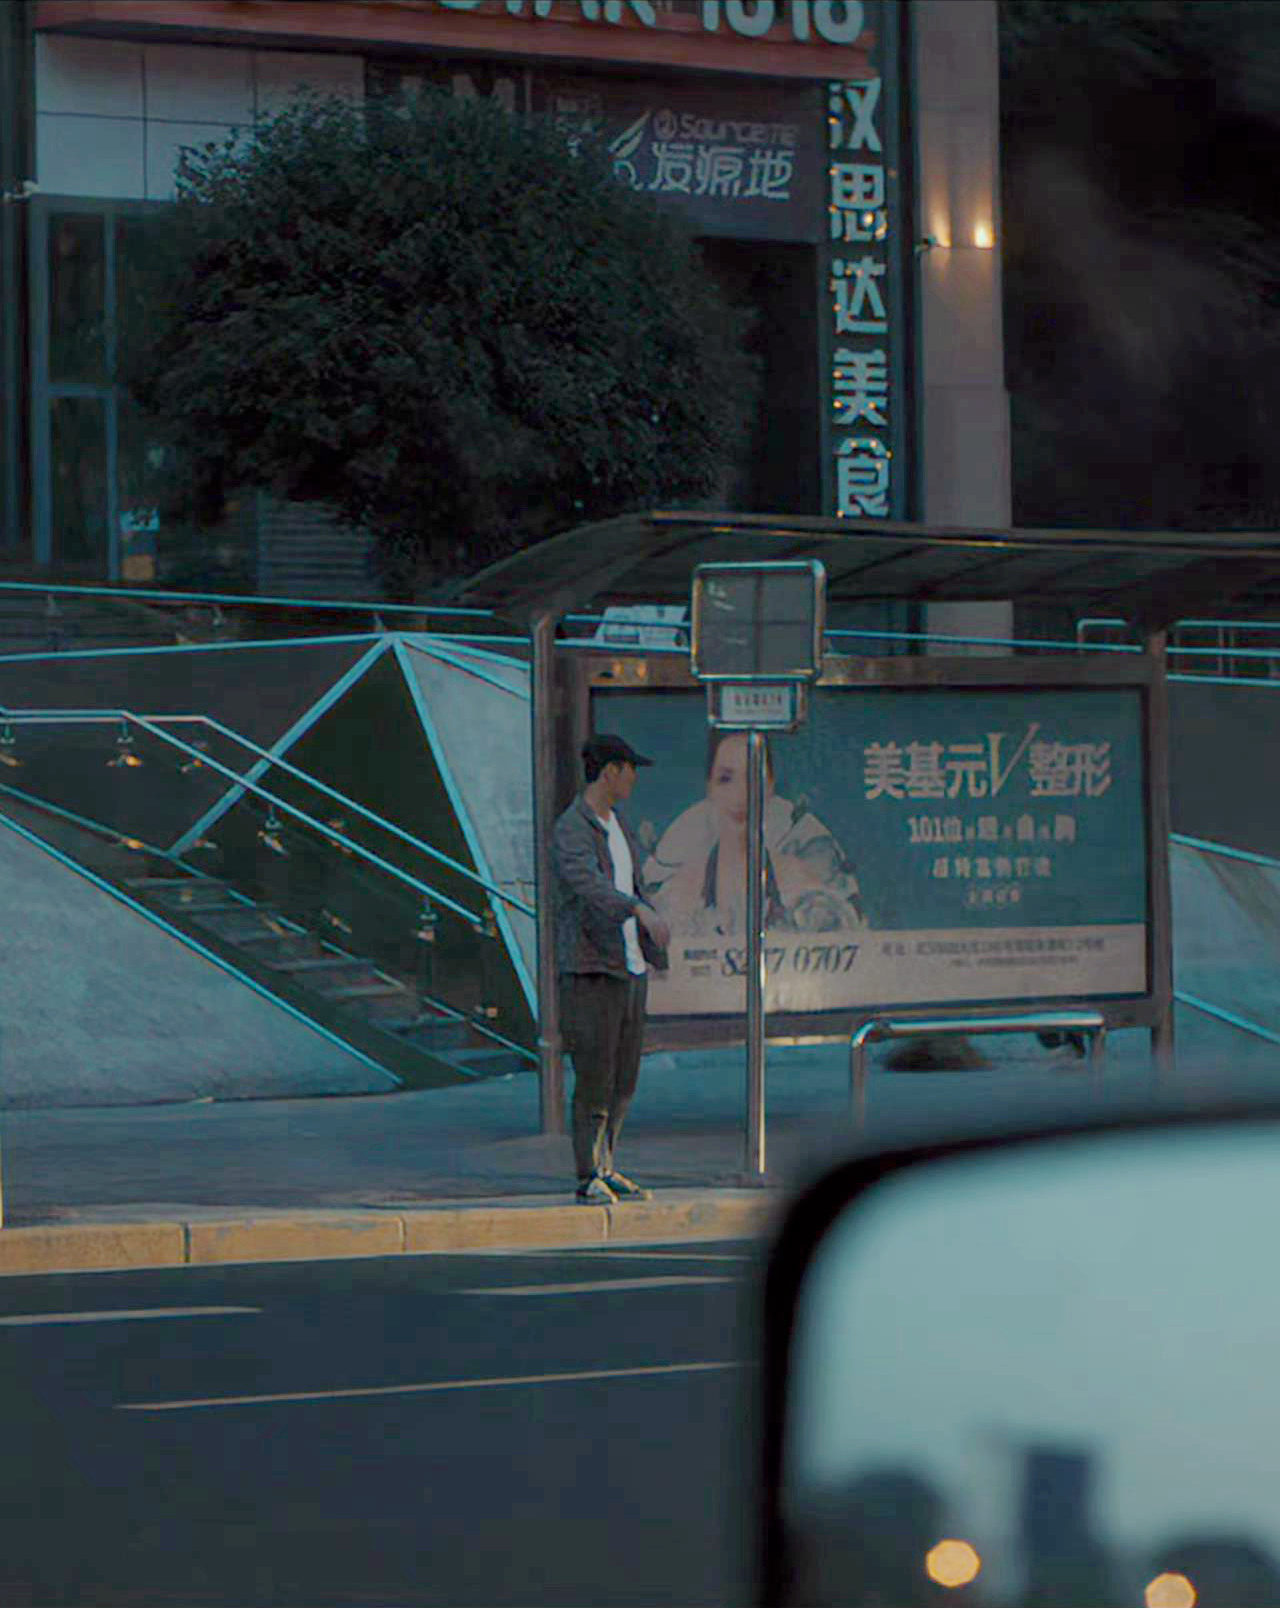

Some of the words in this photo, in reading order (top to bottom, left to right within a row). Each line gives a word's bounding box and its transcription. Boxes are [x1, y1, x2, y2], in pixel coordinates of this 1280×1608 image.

[830, 77, 890, 518] 汉思达美食
[792, 943, 859, 973] 0707
